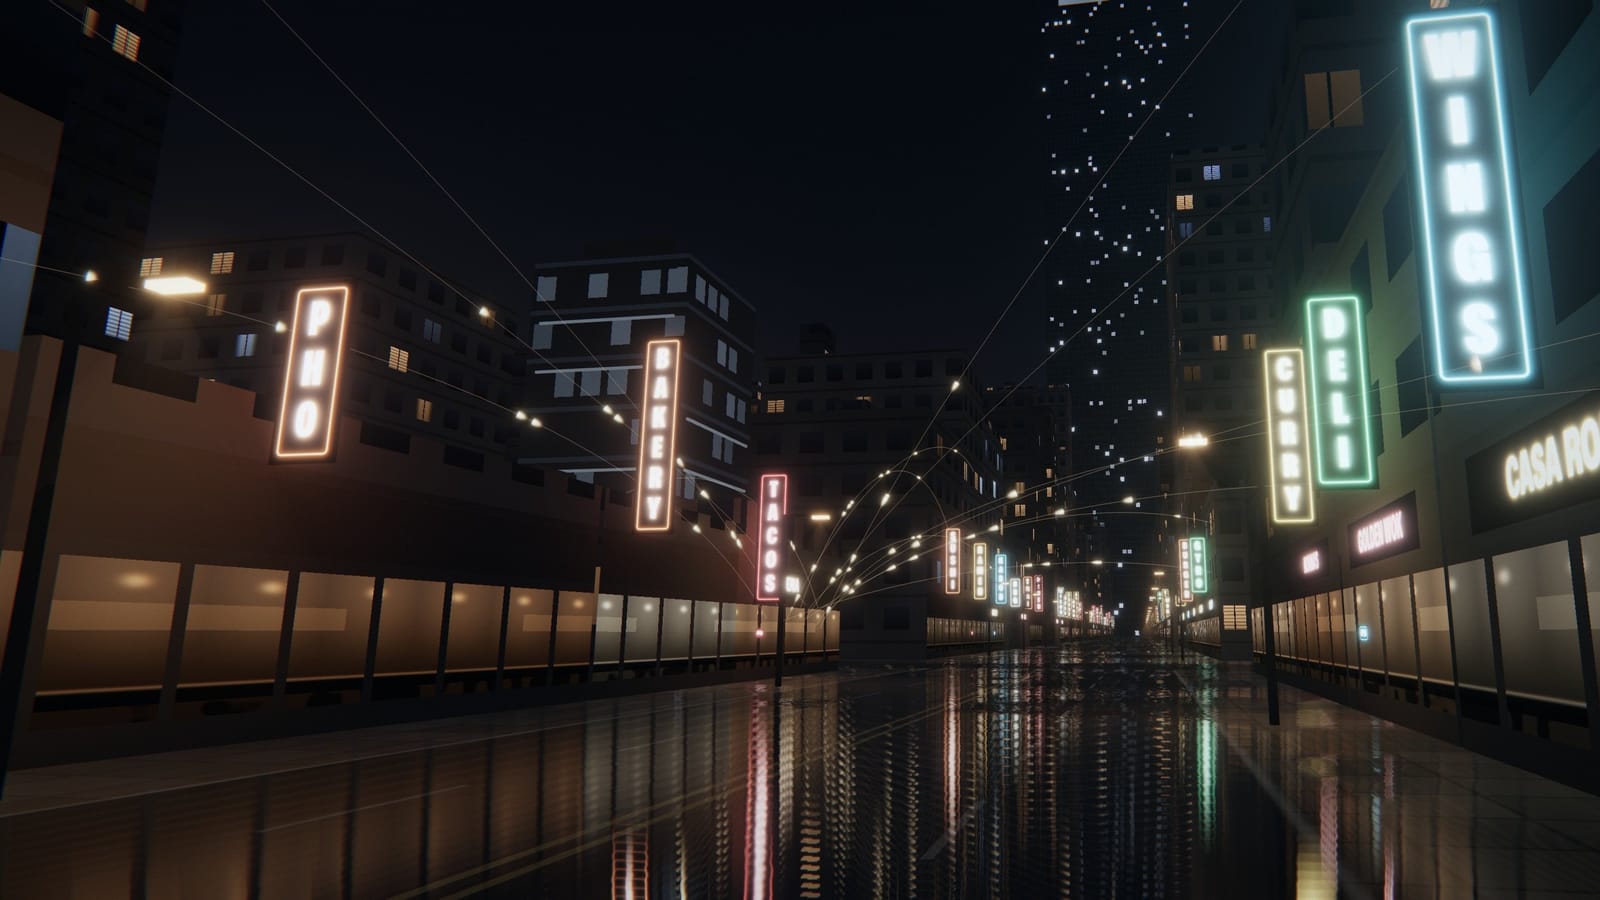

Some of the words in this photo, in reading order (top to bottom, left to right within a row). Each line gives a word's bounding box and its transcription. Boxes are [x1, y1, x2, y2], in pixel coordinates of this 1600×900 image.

[1421, 29, 1500, 356] WINGS
[293, 299, 331, 438] PHO
[647, 347, 670, 520] BAKERY
[1275, 356, 1301, 511] CURRY
[1322, 306, 1351, 470] DELI
[1505, 434, 1563, 500] CASA
[1562, 416, 1600, 479] RO
[765, 480, 779, 593] TACOS
